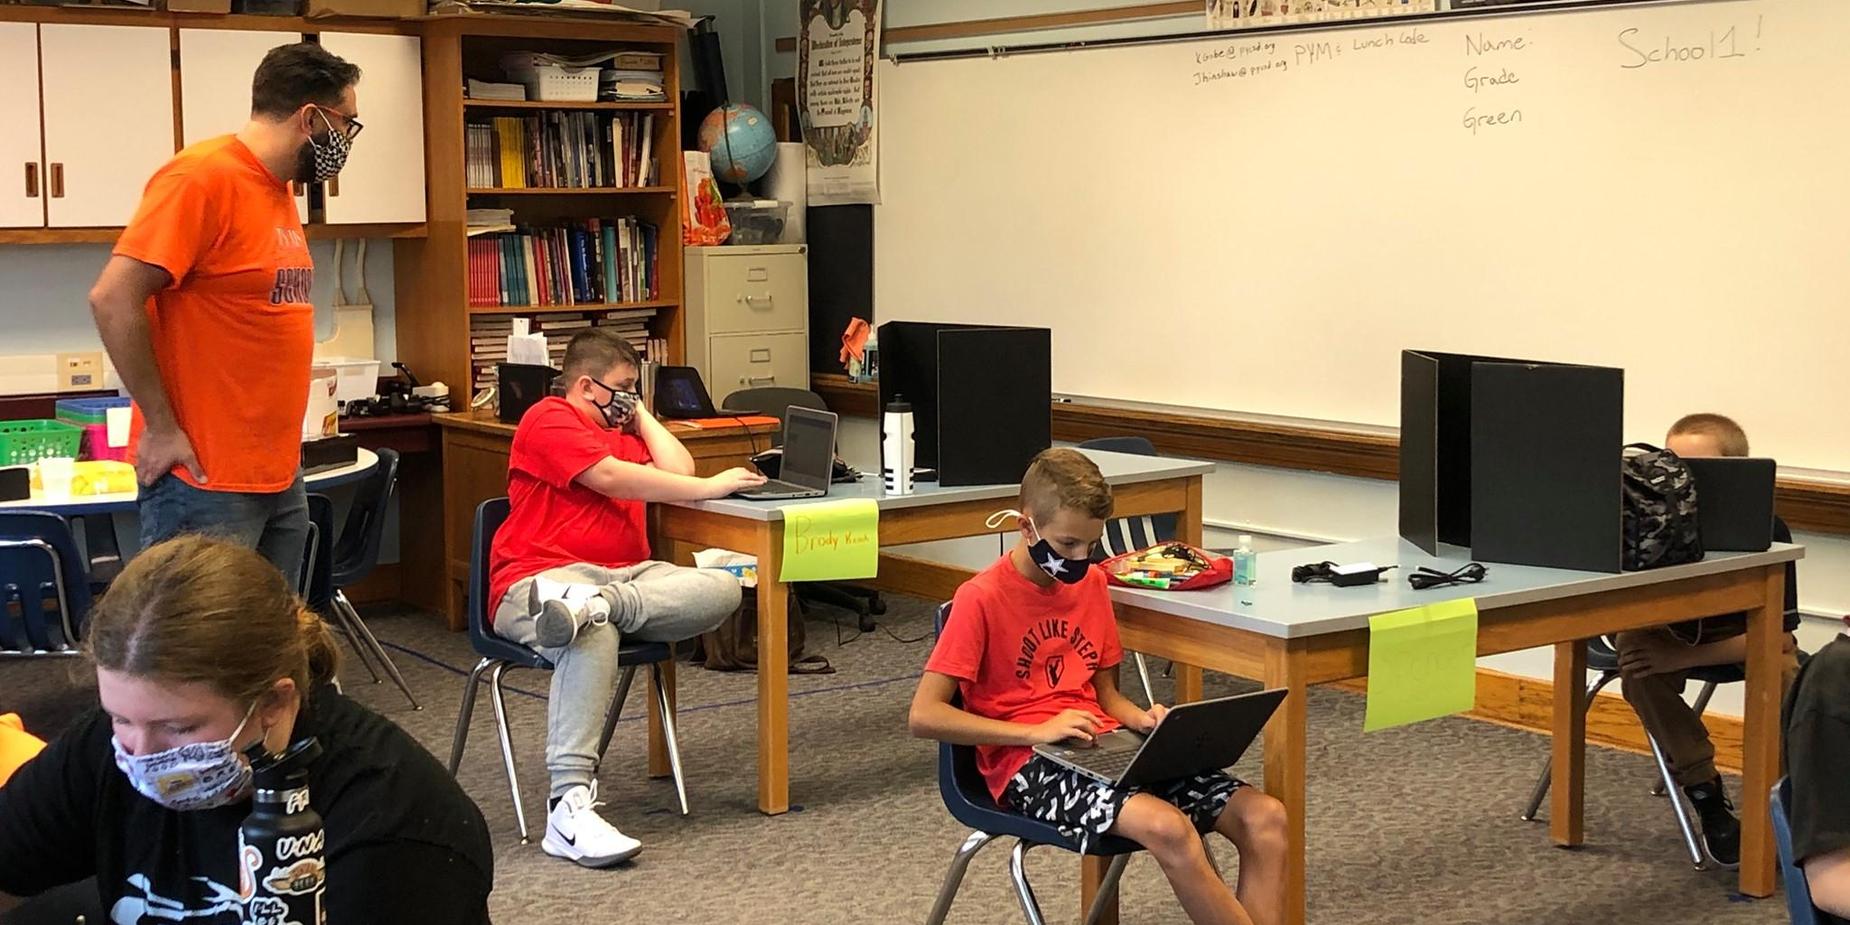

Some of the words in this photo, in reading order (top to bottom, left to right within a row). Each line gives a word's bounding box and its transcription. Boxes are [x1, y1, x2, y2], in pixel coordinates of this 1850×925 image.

[1353, 33, 1394, 51] Lunch
[1464, 67, 1520, 93] Grade
[1463, 107, 1522, 135] Green
[794, 515, 839, 554] Brody
[1015, 627, 1041, 680] SHOOT
[1039, 619, 1069, 641] LIKE
[1070, 626, 1099, 671] STEPH
